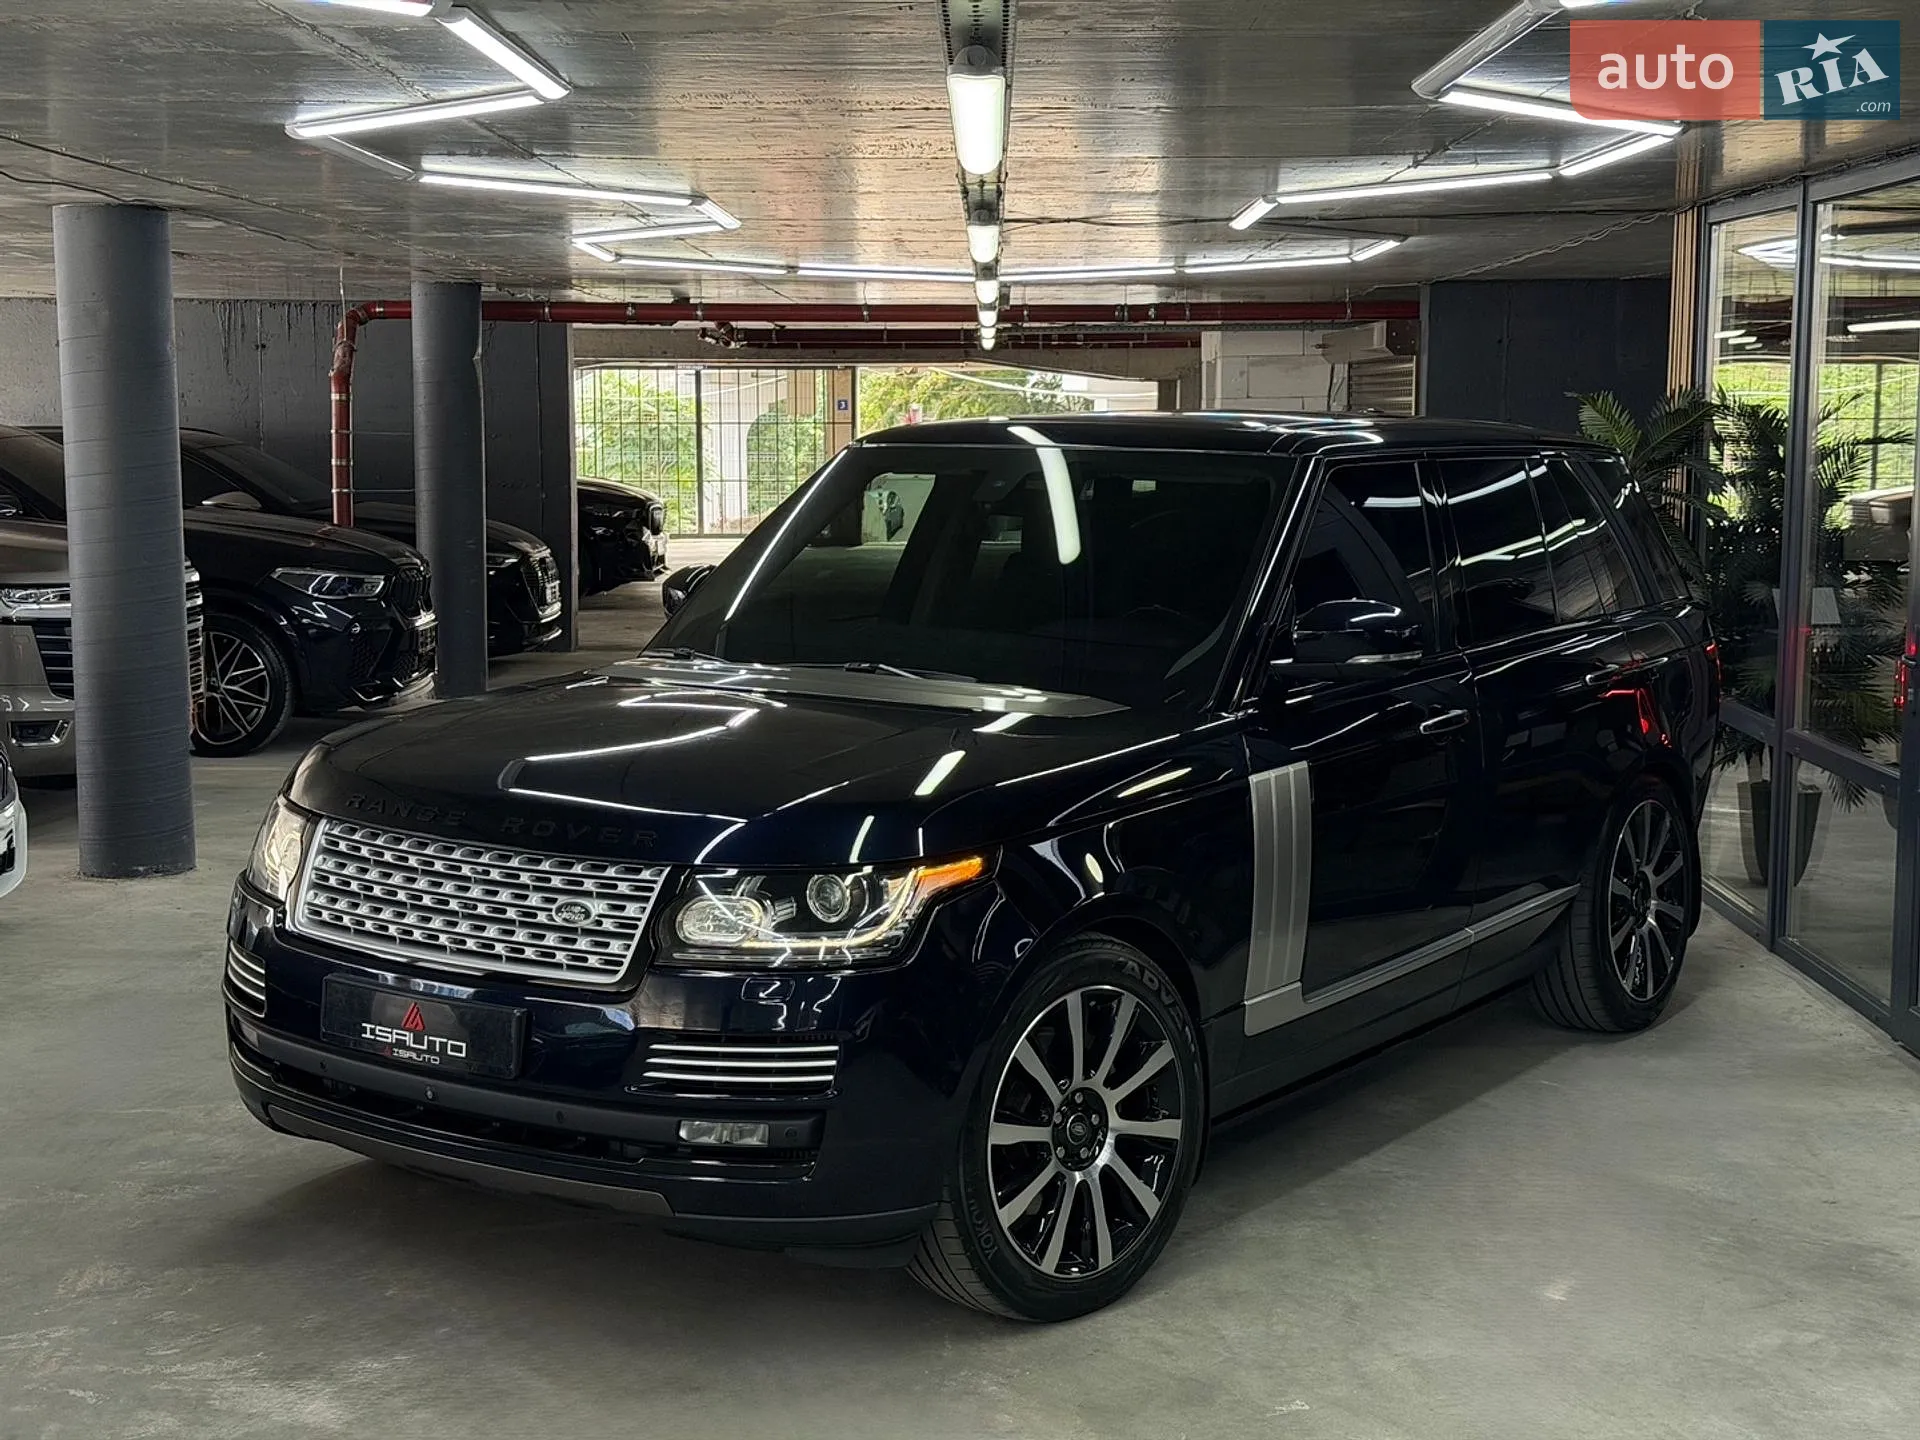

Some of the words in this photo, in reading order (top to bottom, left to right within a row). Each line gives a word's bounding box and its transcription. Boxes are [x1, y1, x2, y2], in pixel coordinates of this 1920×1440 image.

[346, 794, 467, 827] RANGE
[500, 817, 659, 848] ROVER
[361, 1022, 466, 1058] ISAUTO
[392, 1047, 440, 1065] ISAUTO
